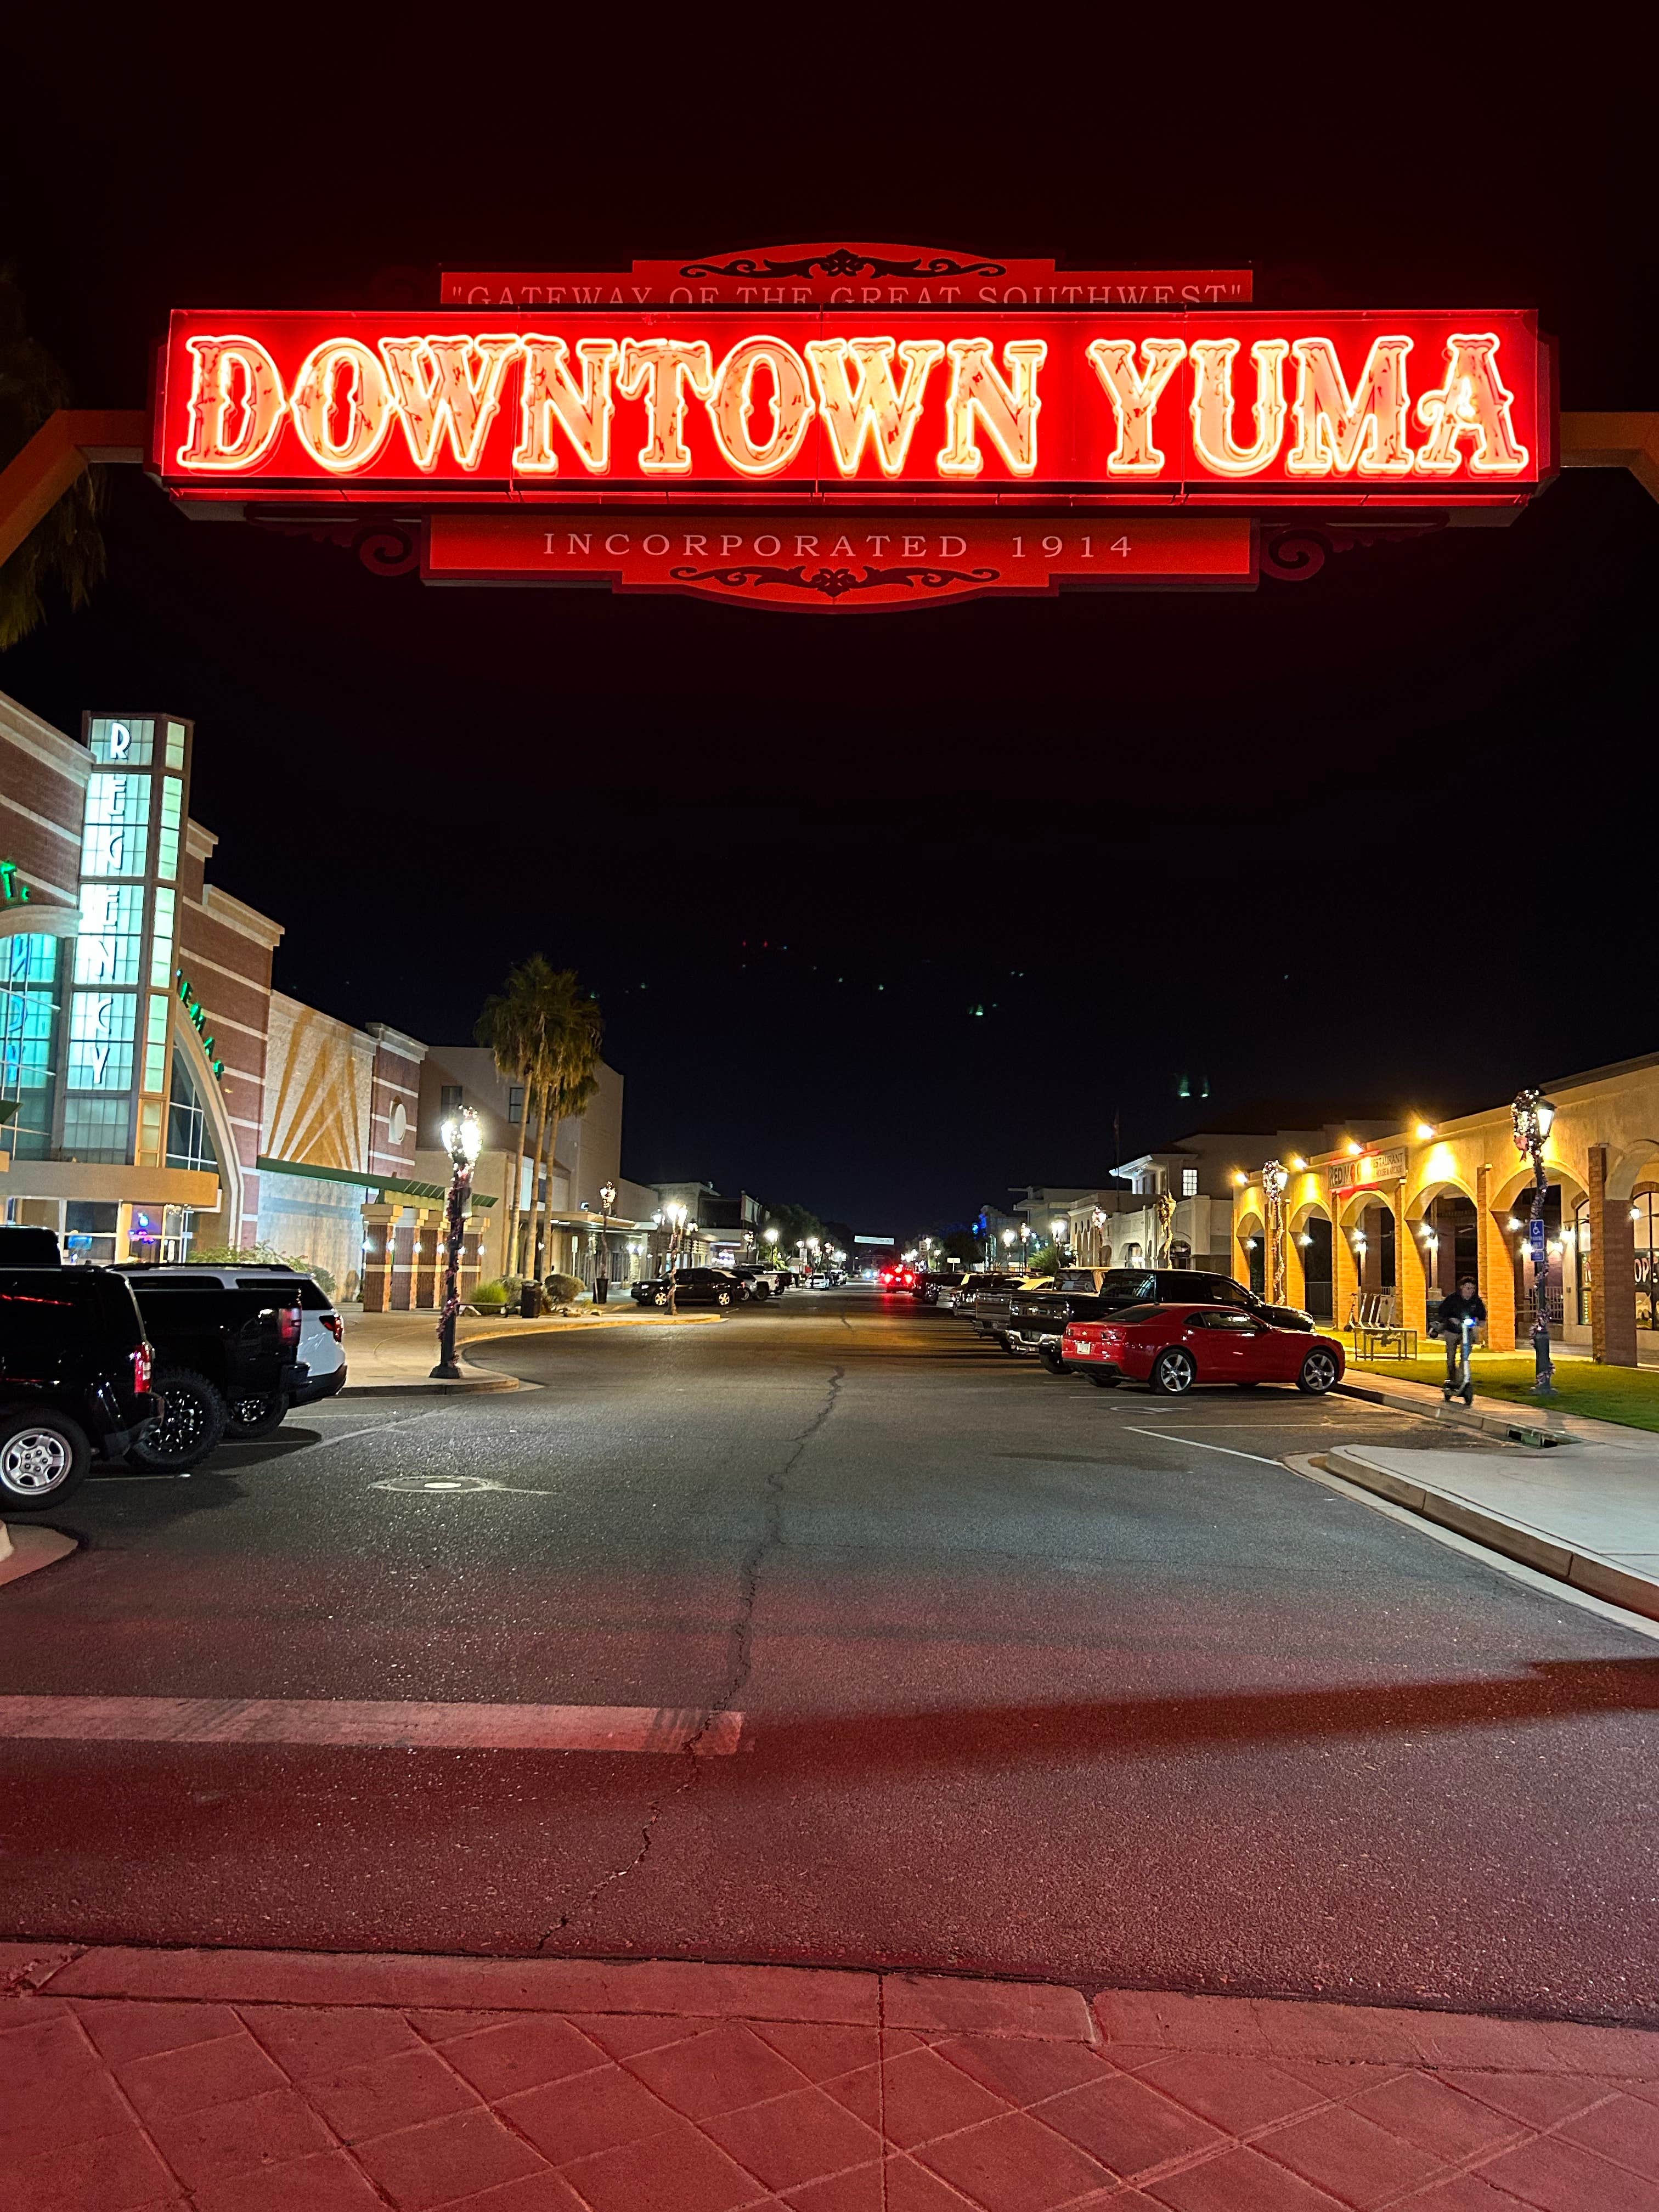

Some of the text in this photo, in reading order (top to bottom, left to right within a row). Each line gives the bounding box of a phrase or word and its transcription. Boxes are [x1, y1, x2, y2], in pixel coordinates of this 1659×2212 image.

[831, 287, 961, 304] GREAT
[176, 331, 1530, 476] DOWNTOWN YUMA
[543, 533, 1132, 558] INCORPORATED 1914
[91, 721, 132, 1085] REGENCY
[1329, 1166, 1343, 1187] RED
